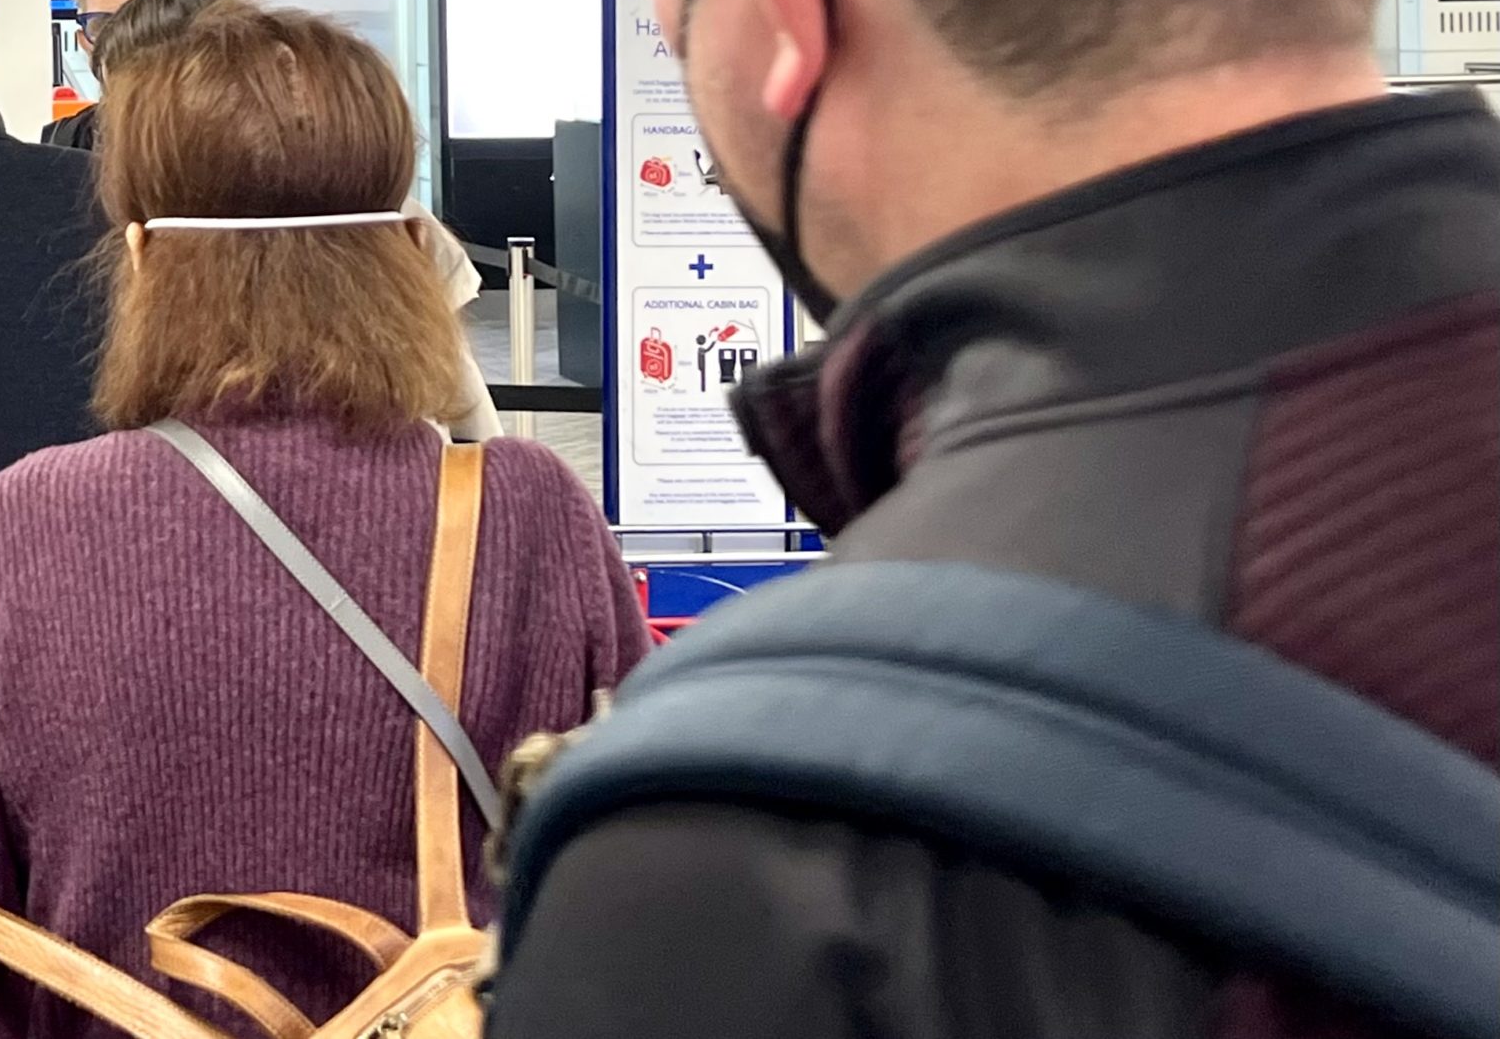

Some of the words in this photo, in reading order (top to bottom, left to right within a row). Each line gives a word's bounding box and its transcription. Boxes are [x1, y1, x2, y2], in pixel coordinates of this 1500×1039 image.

[644, 299, 705, 309] ADDITIONAL
[706, 299, 736, 309] CABIN
[738, 299, 759, 309] BAG
